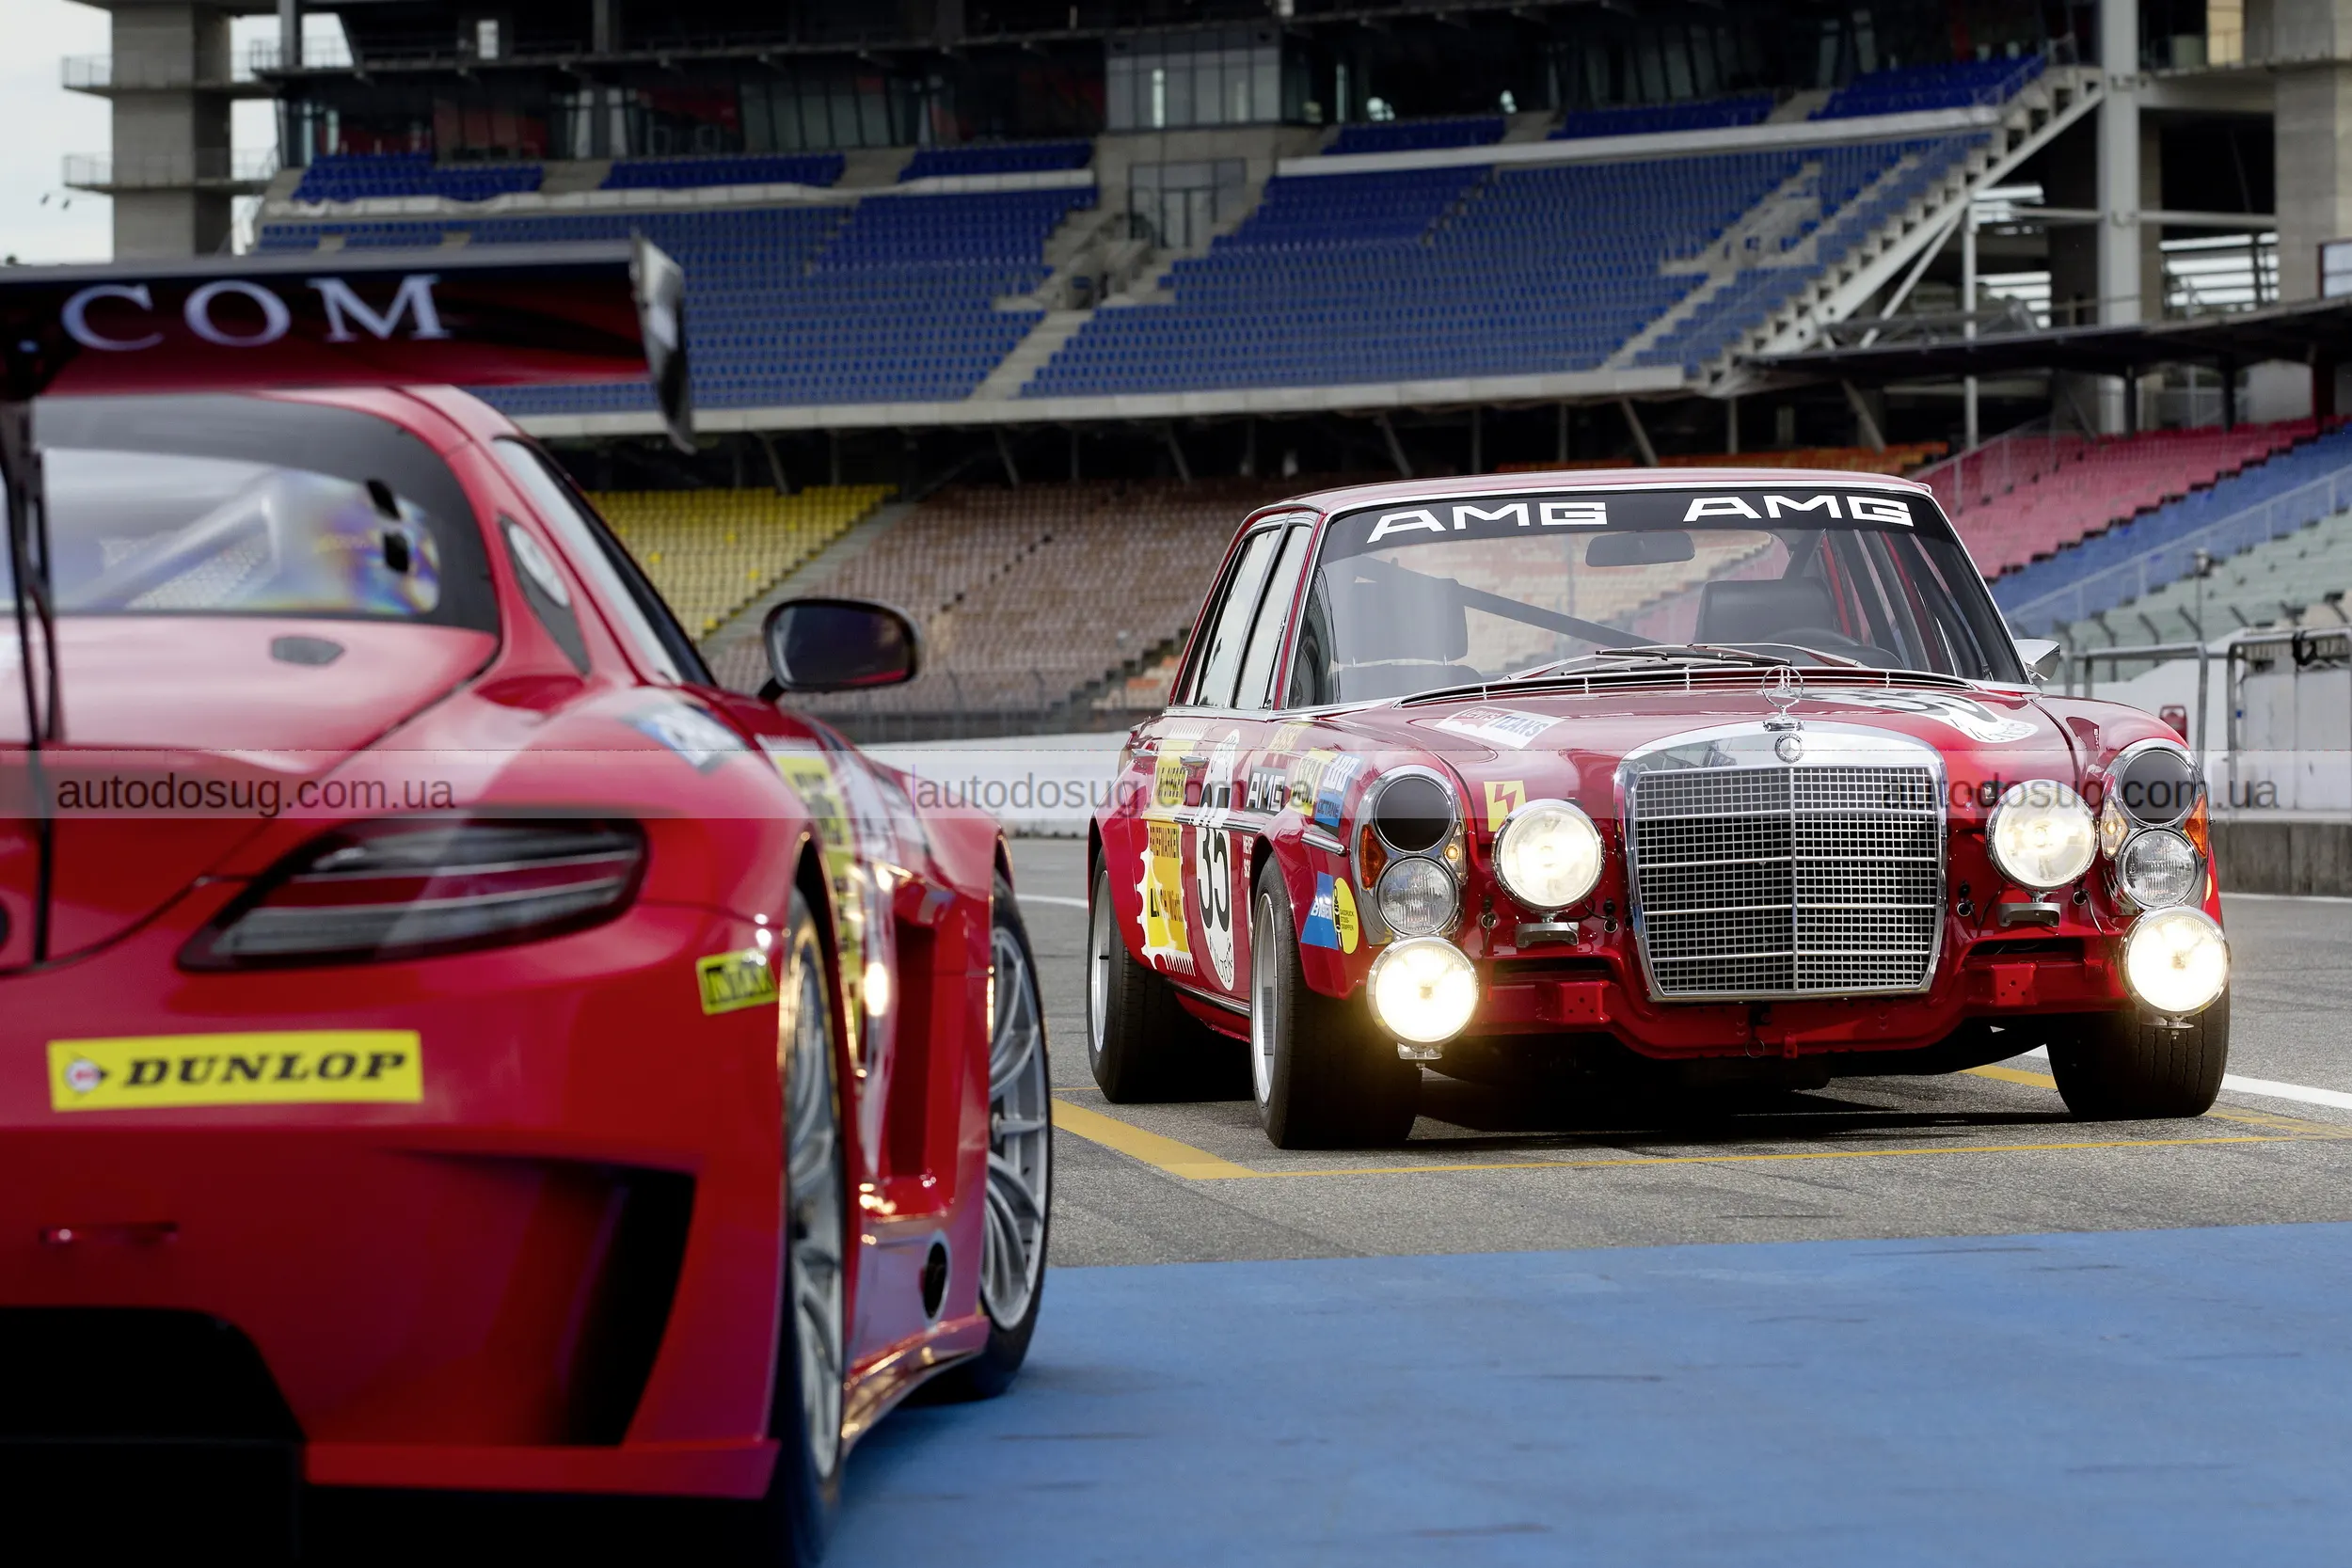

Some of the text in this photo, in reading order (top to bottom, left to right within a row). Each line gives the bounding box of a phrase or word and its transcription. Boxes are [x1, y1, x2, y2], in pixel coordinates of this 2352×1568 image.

[61, 274, 452, 352] COM
[1366, 495, 1915, 544] AMG AMG
[1247, 772, 1286, 812] AMG
[1198, 783, 1232, 932] 35
[119, 1051, 406, 1089] DUNLOP
